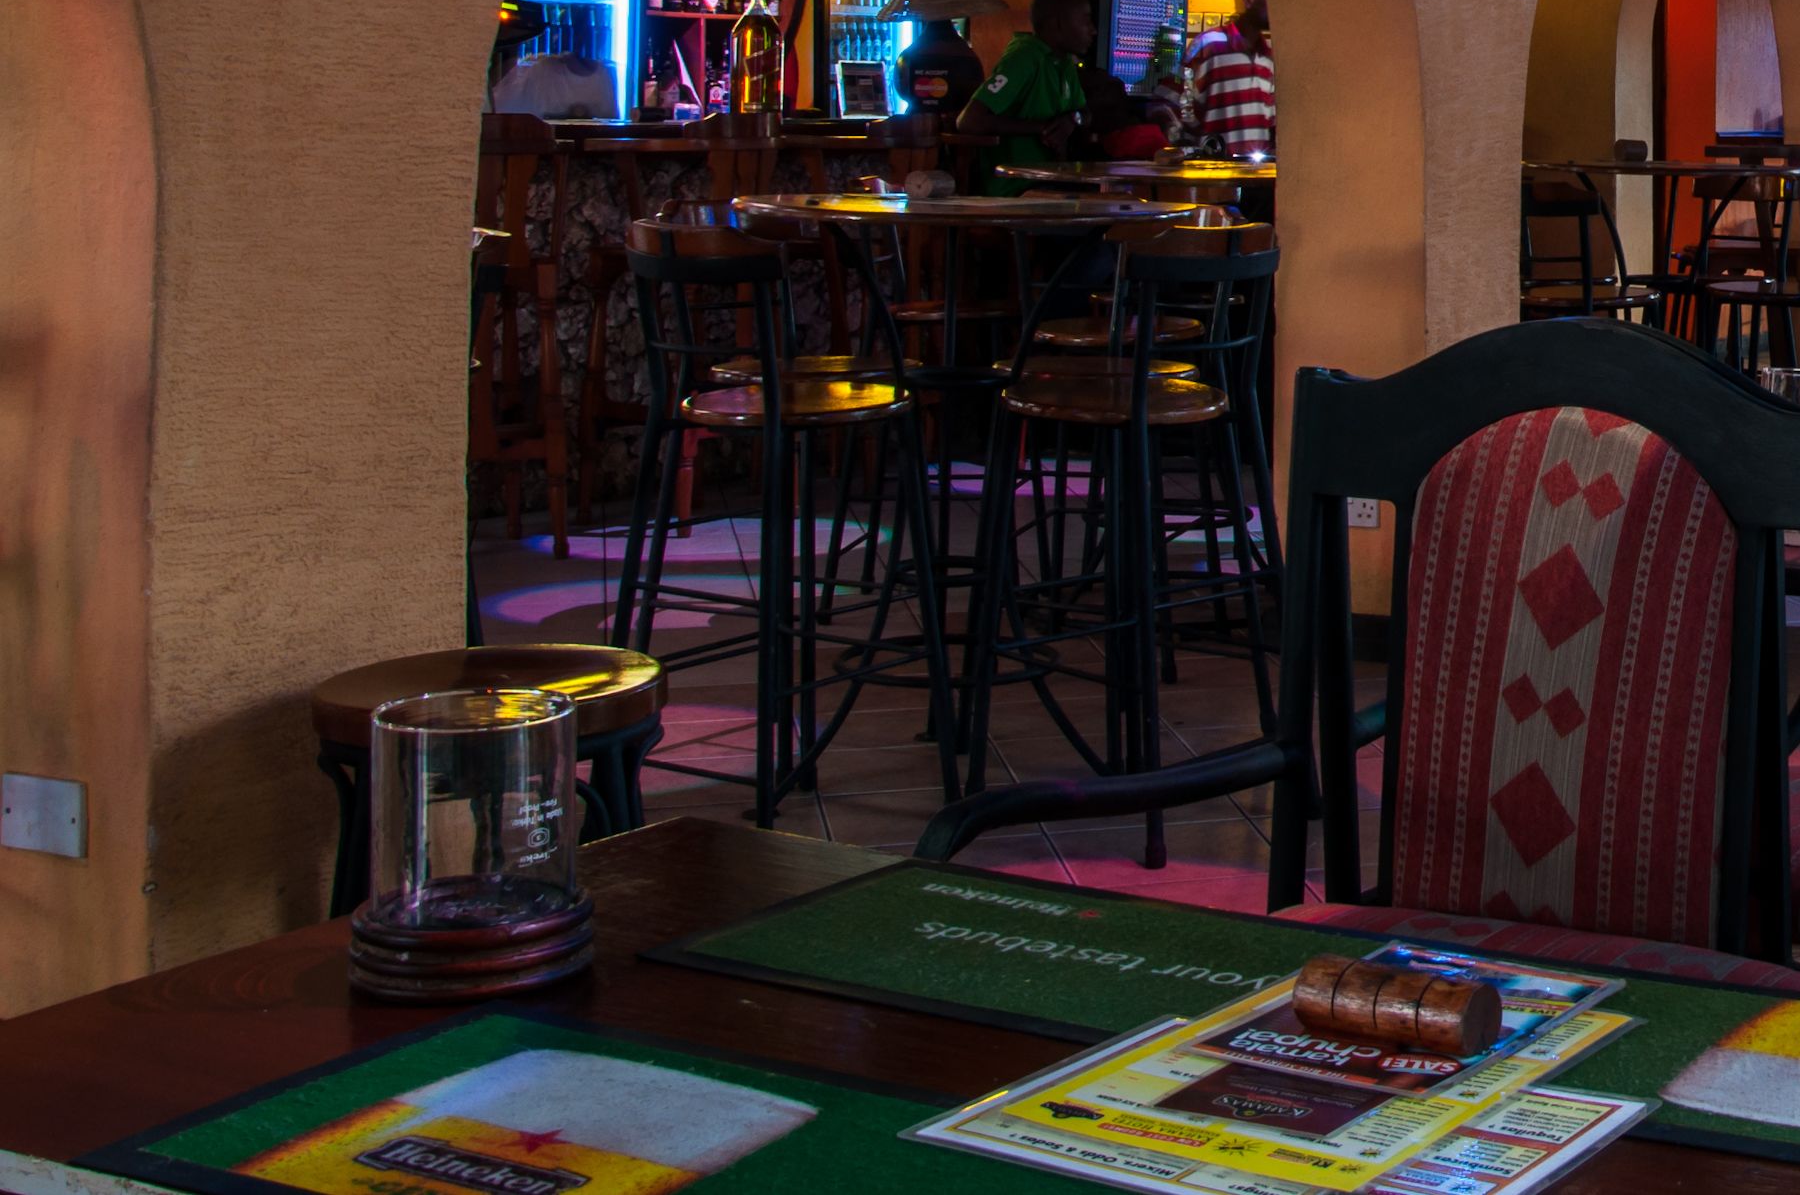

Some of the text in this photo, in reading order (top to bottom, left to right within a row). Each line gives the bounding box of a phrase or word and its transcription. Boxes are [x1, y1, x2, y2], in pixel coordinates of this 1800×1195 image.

[988, 74, 1008, 93] 3
[922, 884, 1072, 916] Heineken
[914, 922, 1281, 990] your tastebuds
[1229, 1039, 1351, 1065] kamata
[1240, 1028, 1382, 1058] chupa!
[1380, 1057, 1458, 1074] SALE!
[1220, 1095, 1305, 1117] KAHAMAS
[1020, 1135, 1064, 1151] Sodas
[1501, 1125, 1564, 1142] Tequilas
[1080, 1147, 1118, 1163] Odds
[381, 1143, 557, 1195] Heineken
[1433, 1156, 1514, 1177] Sambucas
